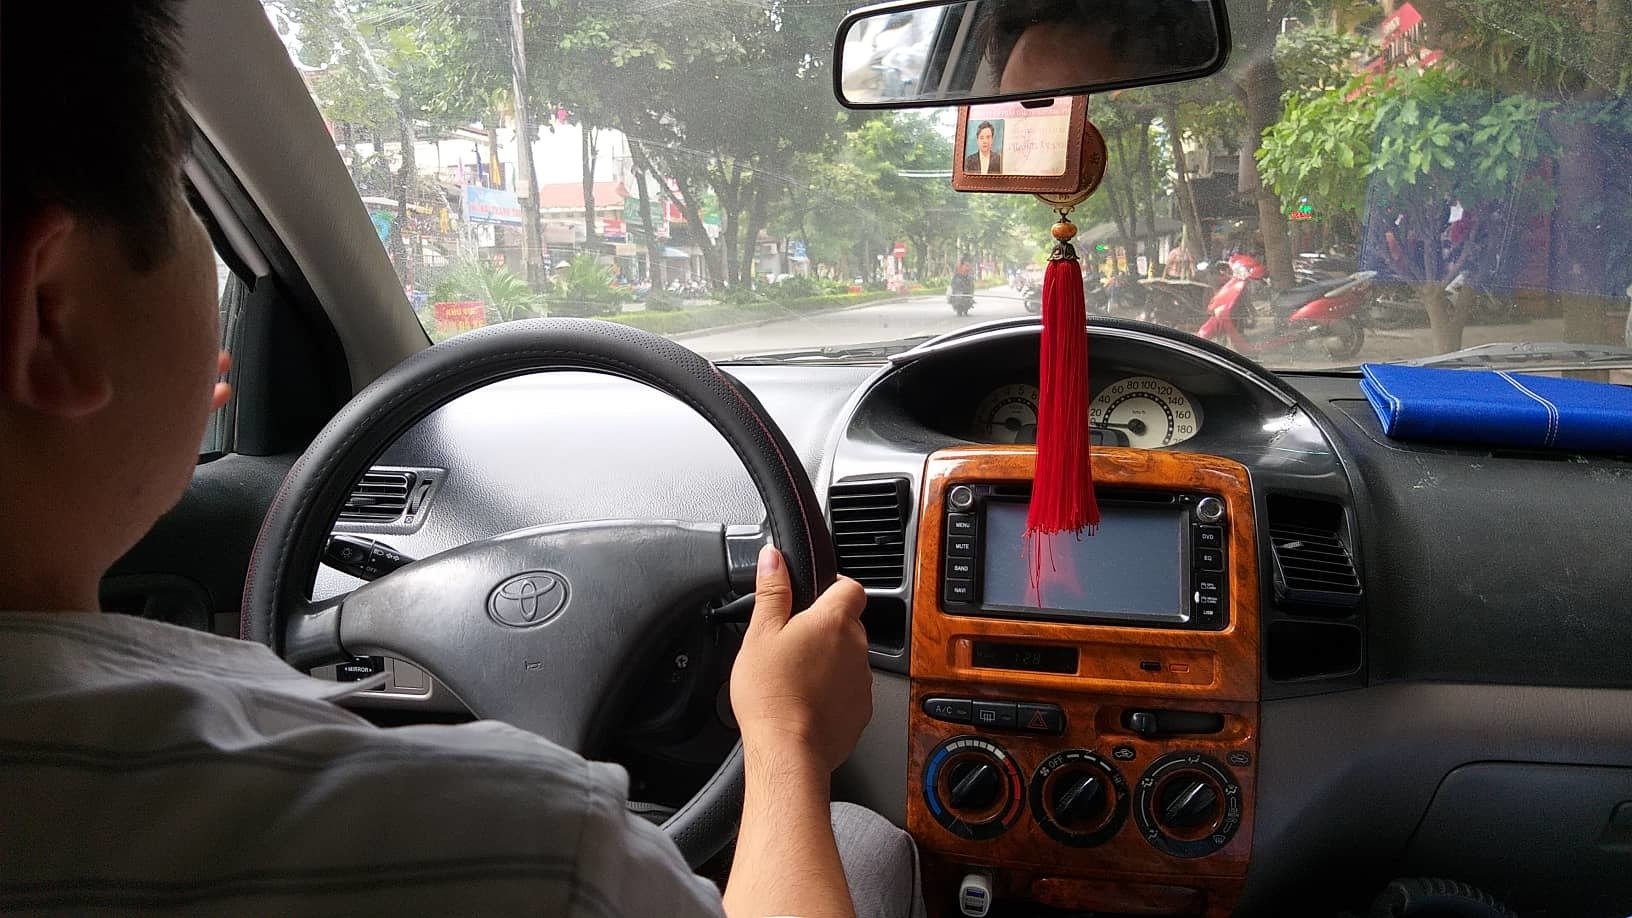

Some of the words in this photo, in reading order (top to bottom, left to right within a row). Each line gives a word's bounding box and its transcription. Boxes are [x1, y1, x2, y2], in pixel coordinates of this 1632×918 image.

[1111, 385, 1124, 394] 60
[1127, 381, 1139, 390] 80
[1141, 380, 1157, 390] 100
[1158, 386, 1173, 396] 120
[1098, 395, 1110, 404] 40
[1168, 396, 1184, 406] 140
[1090, 408, 1102, 417] 20
[1175, 410, 1191, 419] 160
[1177, 425, 1193, 434] 180
[935, 704, 953, 715] A/C
[1048, 755, 1064, 769] OFF
